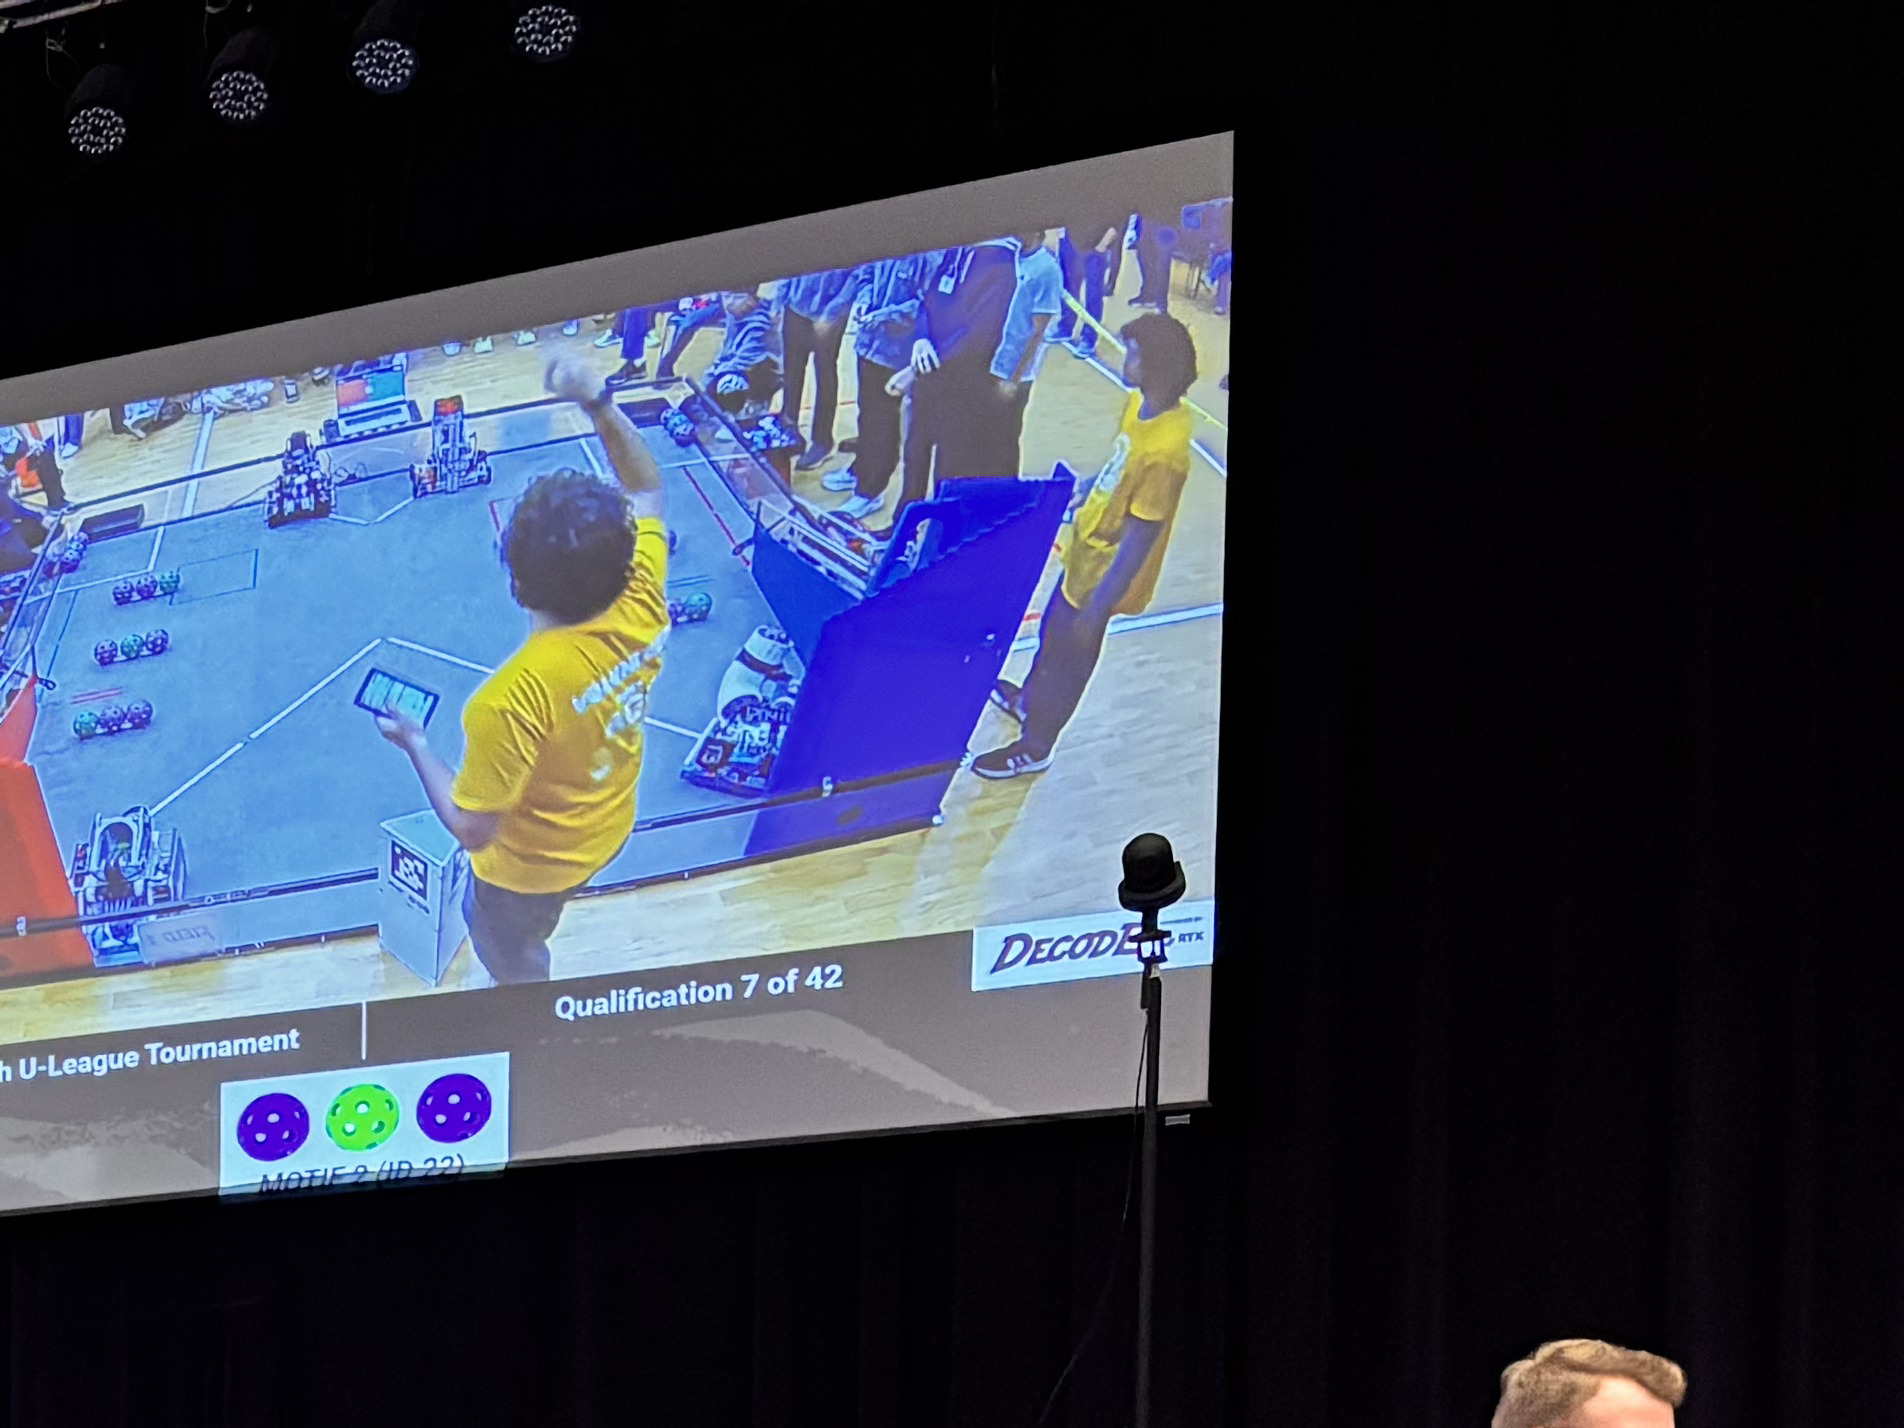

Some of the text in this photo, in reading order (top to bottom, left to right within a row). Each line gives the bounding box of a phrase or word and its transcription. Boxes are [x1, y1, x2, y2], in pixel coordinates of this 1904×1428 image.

[555, 964, 843, 1021] Qualification 7 of 42
[19, 1048, 139, 1081] U-League
[145, 1028, 301, 1070] Tournament
